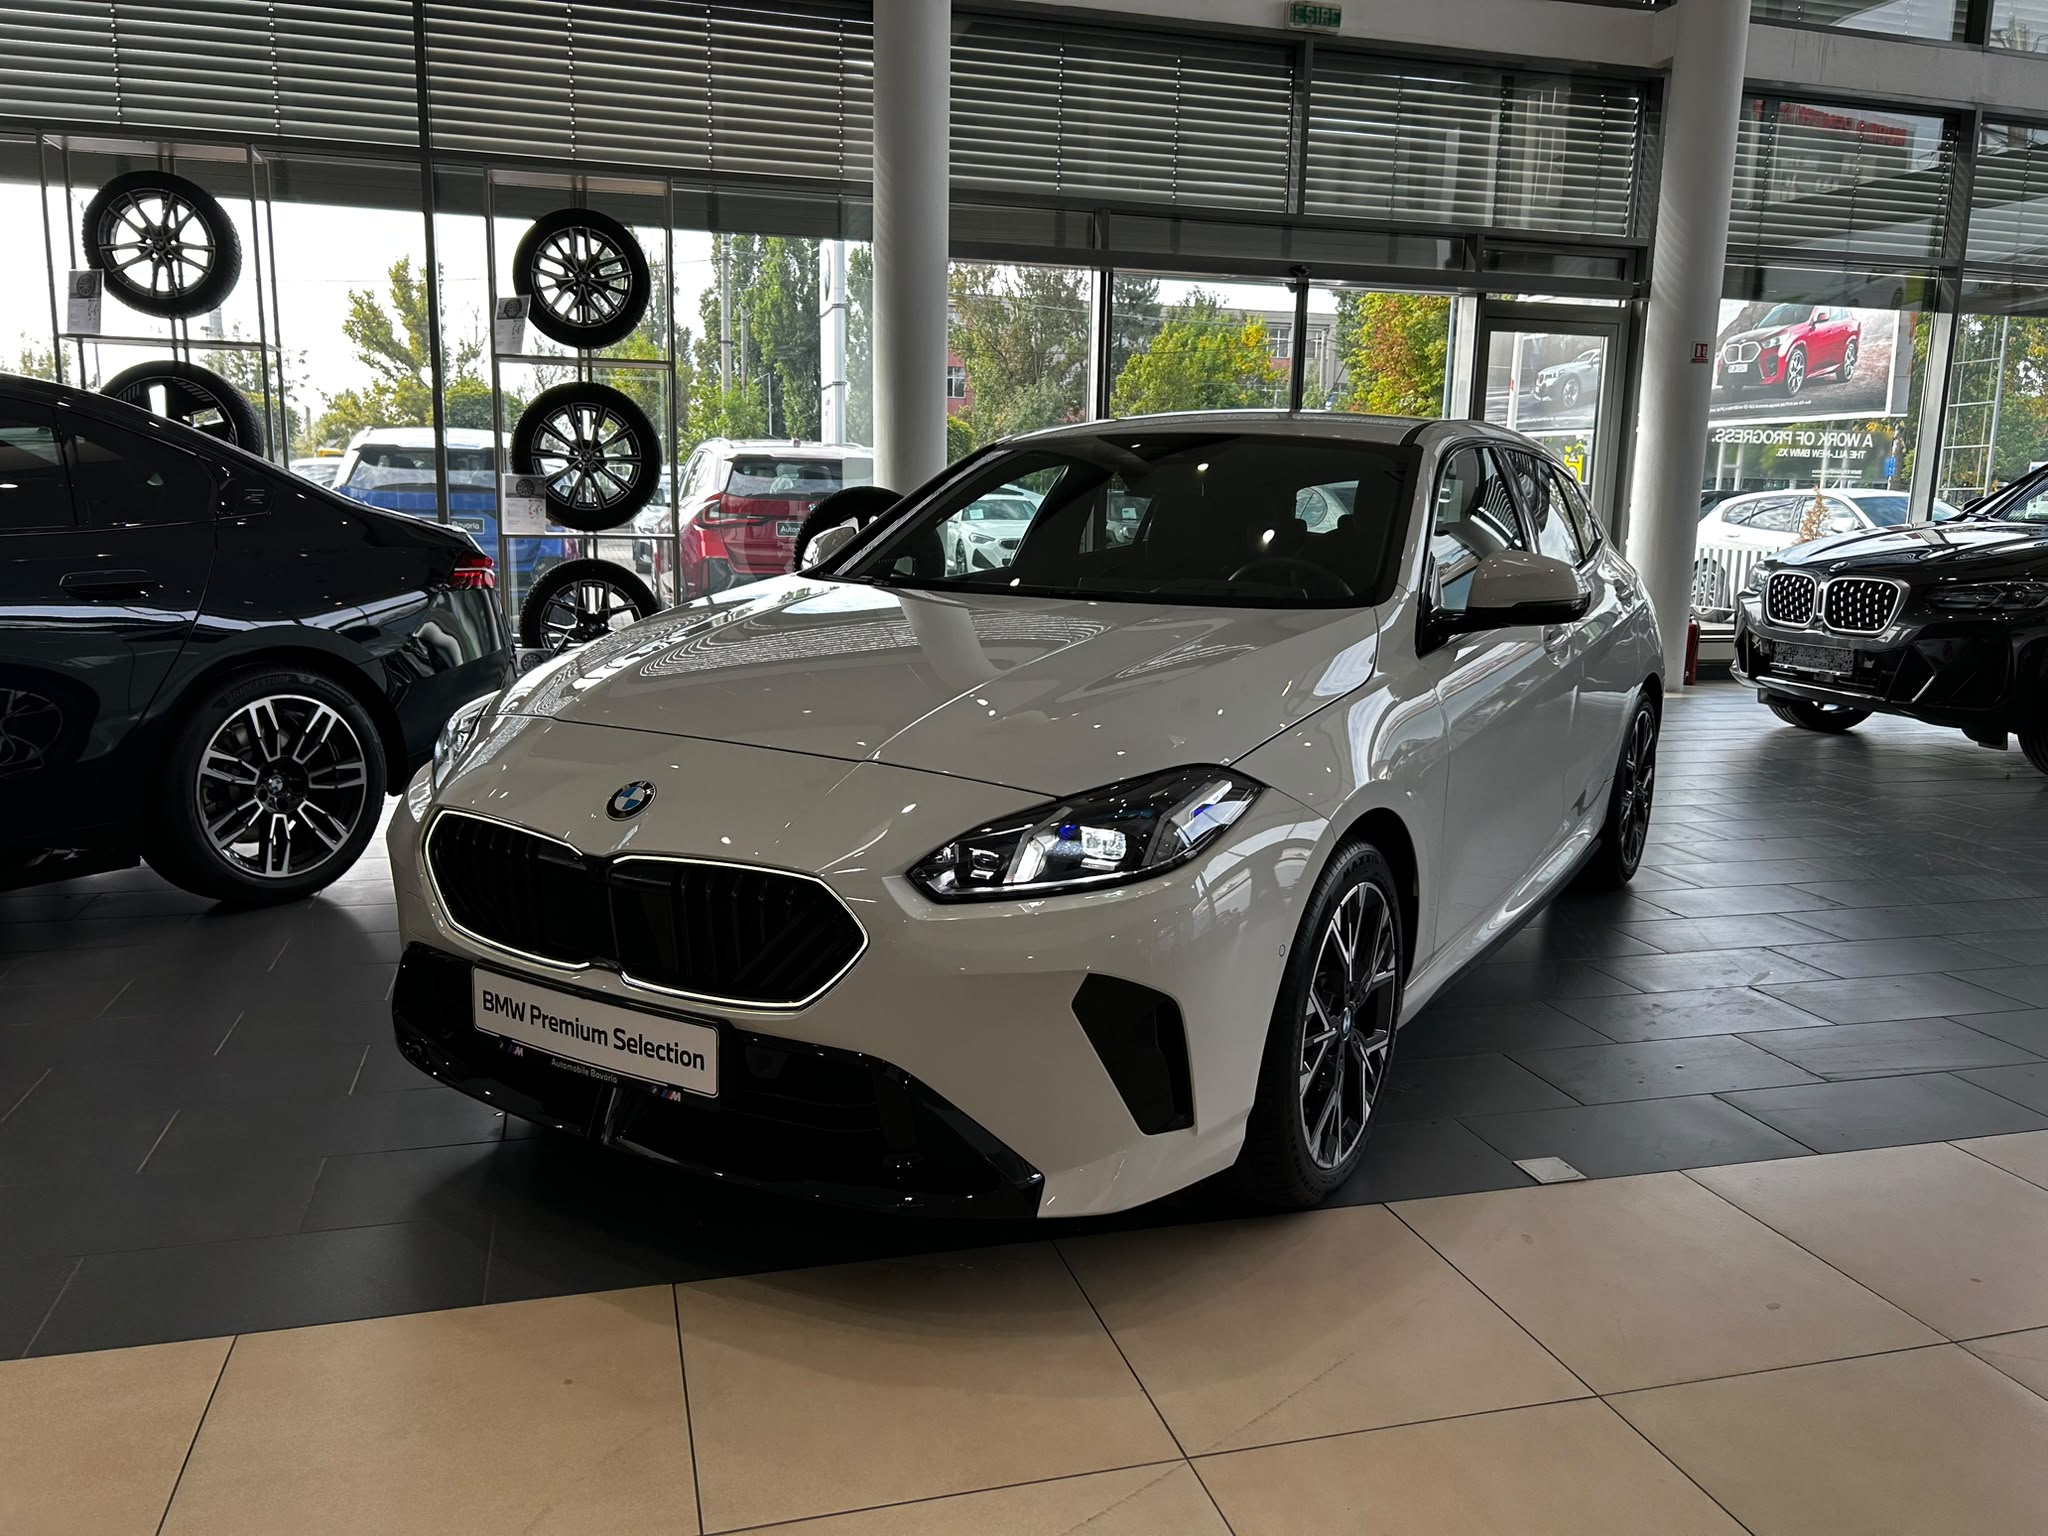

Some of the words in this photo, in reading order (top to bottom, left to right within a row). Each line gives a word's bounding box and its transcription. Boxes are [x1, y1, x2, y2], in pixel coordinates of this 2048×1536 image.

[482, 989, 526, 1022] BMW
[529, 1004, 608, 1047] Premium
[613, 1027, 705, 1071] Selection
[551, 1058, 589, 1077] Automobile
[590, 1068, 618, 1084] Bavaria
